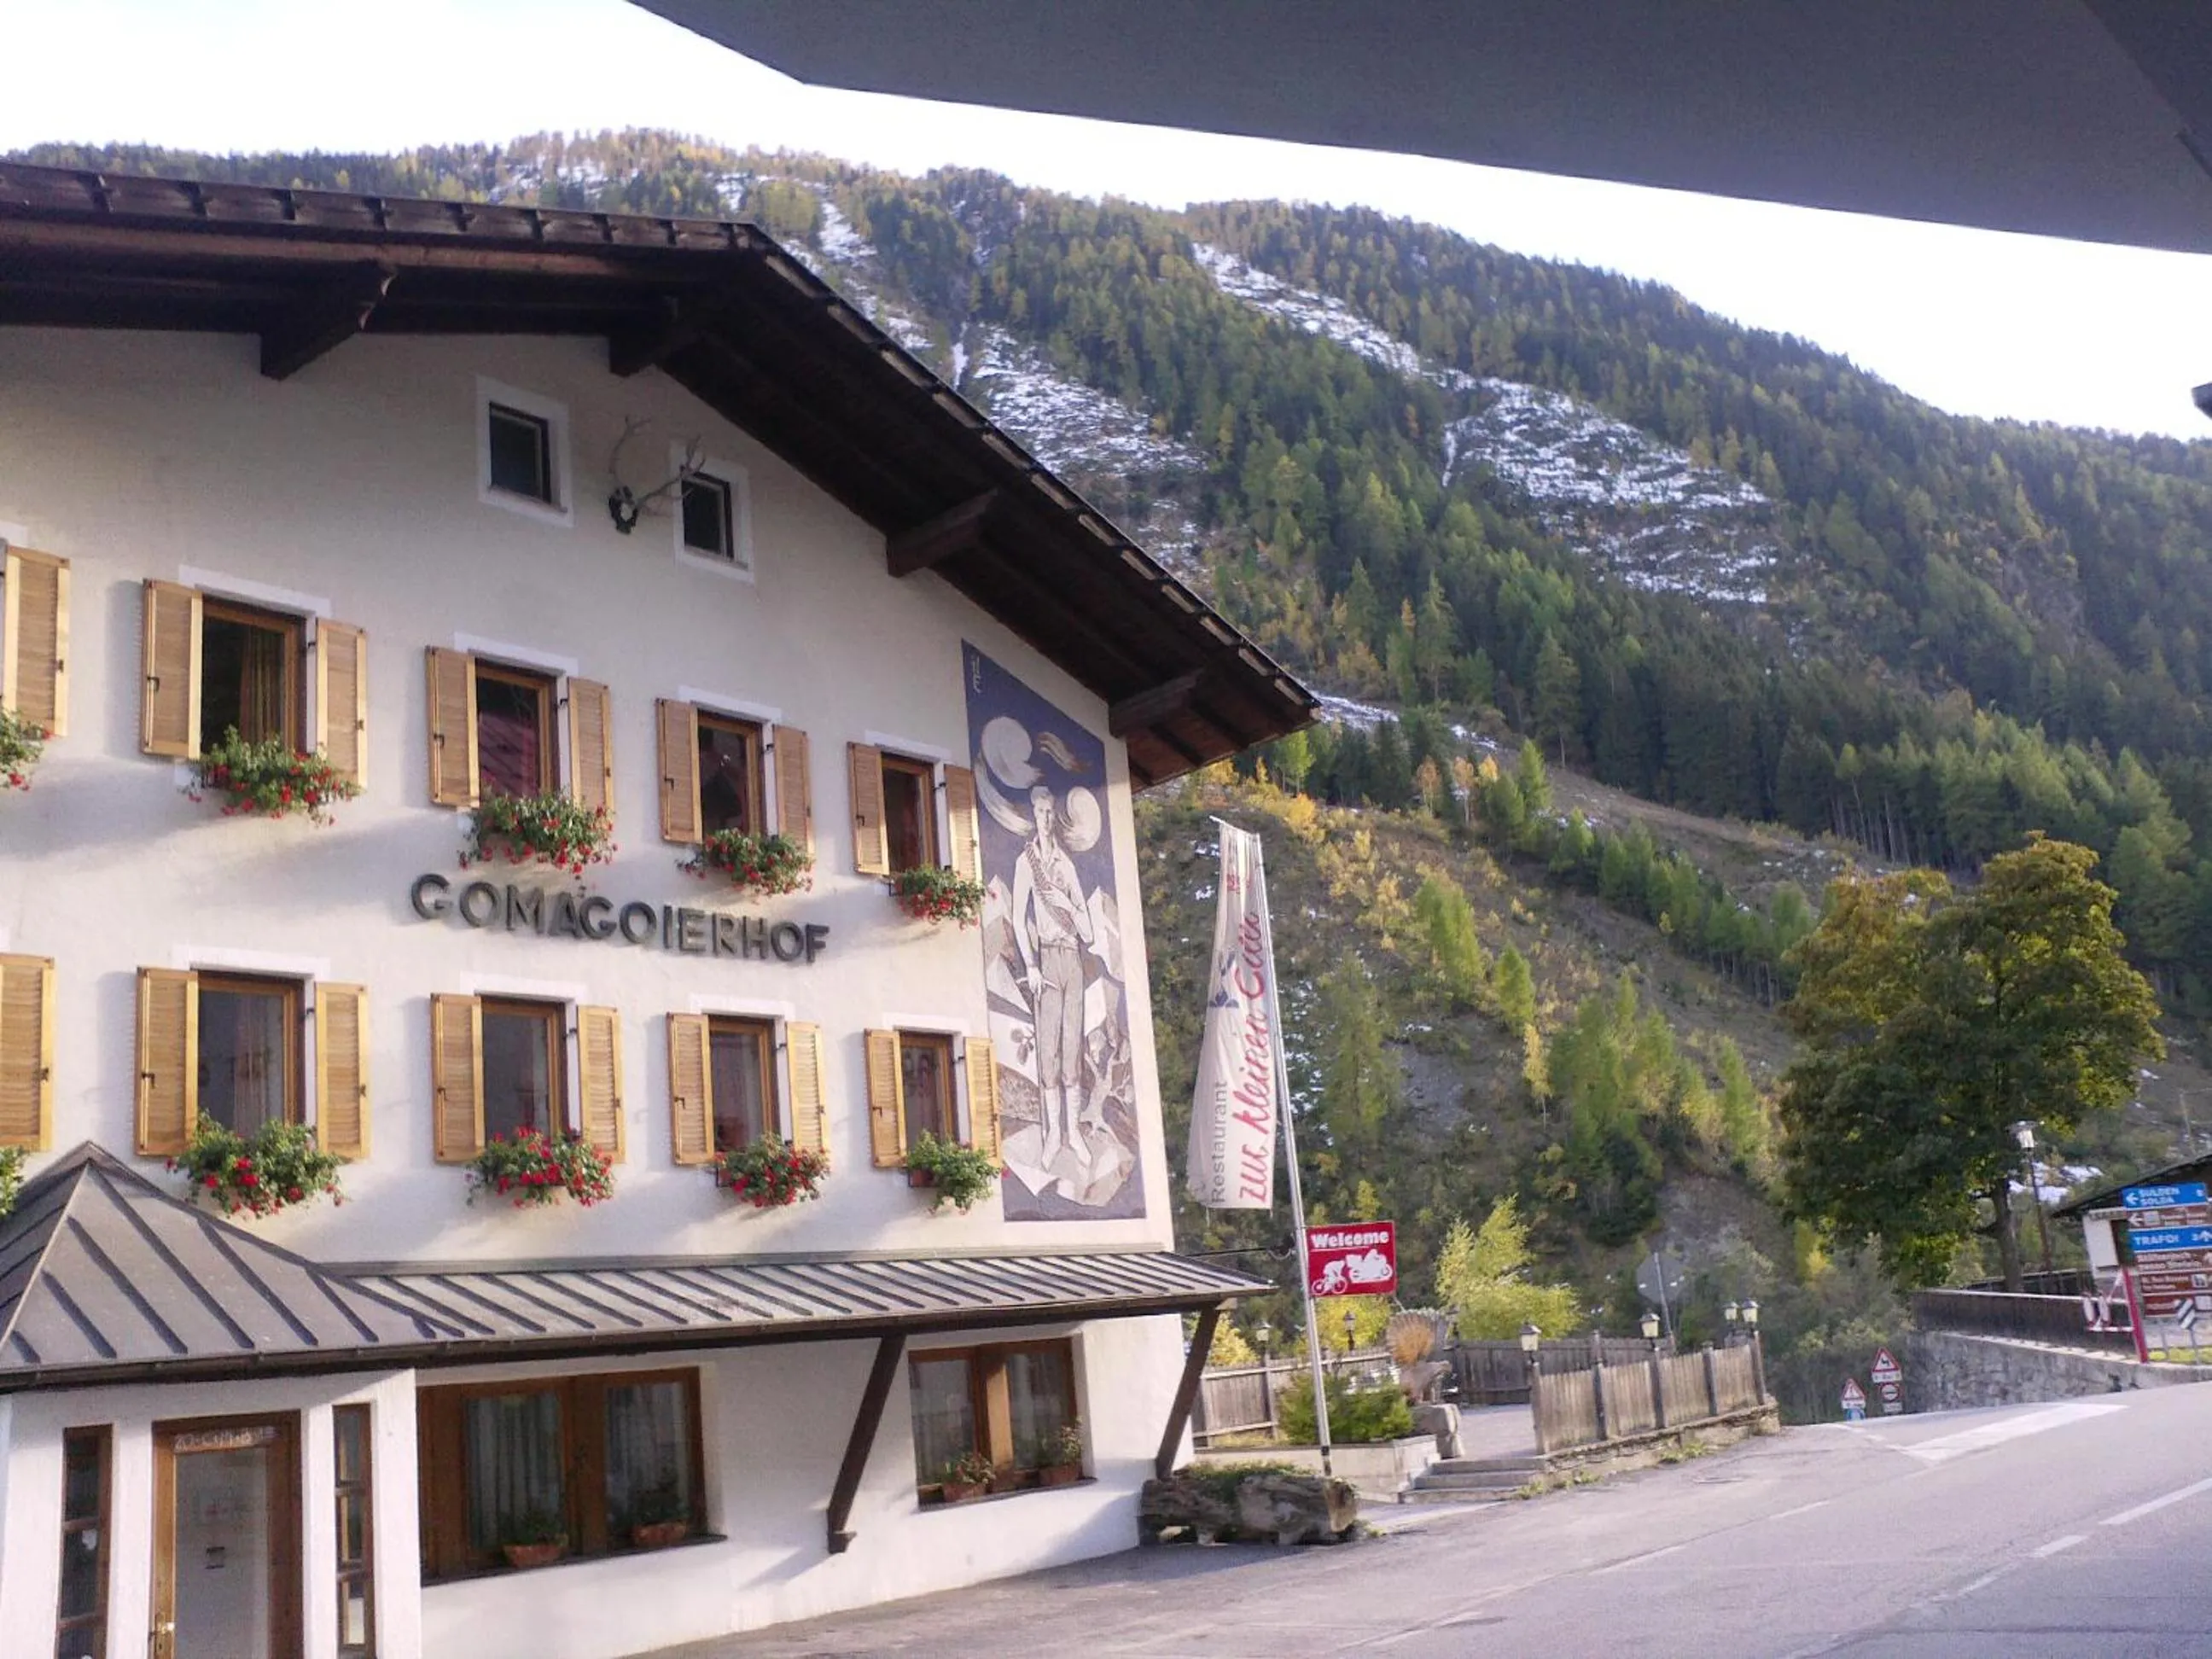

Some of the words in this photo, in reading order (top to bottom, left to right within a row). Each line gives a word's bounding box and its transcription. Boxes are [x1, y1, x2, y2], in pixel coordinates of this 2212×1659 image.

[410, 872, 831, 963] GOMAGOIERHOF
[1211, 1080, 1228, 1203] Restaurant
[1311, 1231, 1389, 1249] Welcome
[2134, 1234, 2180, 1246] TRAFOI
